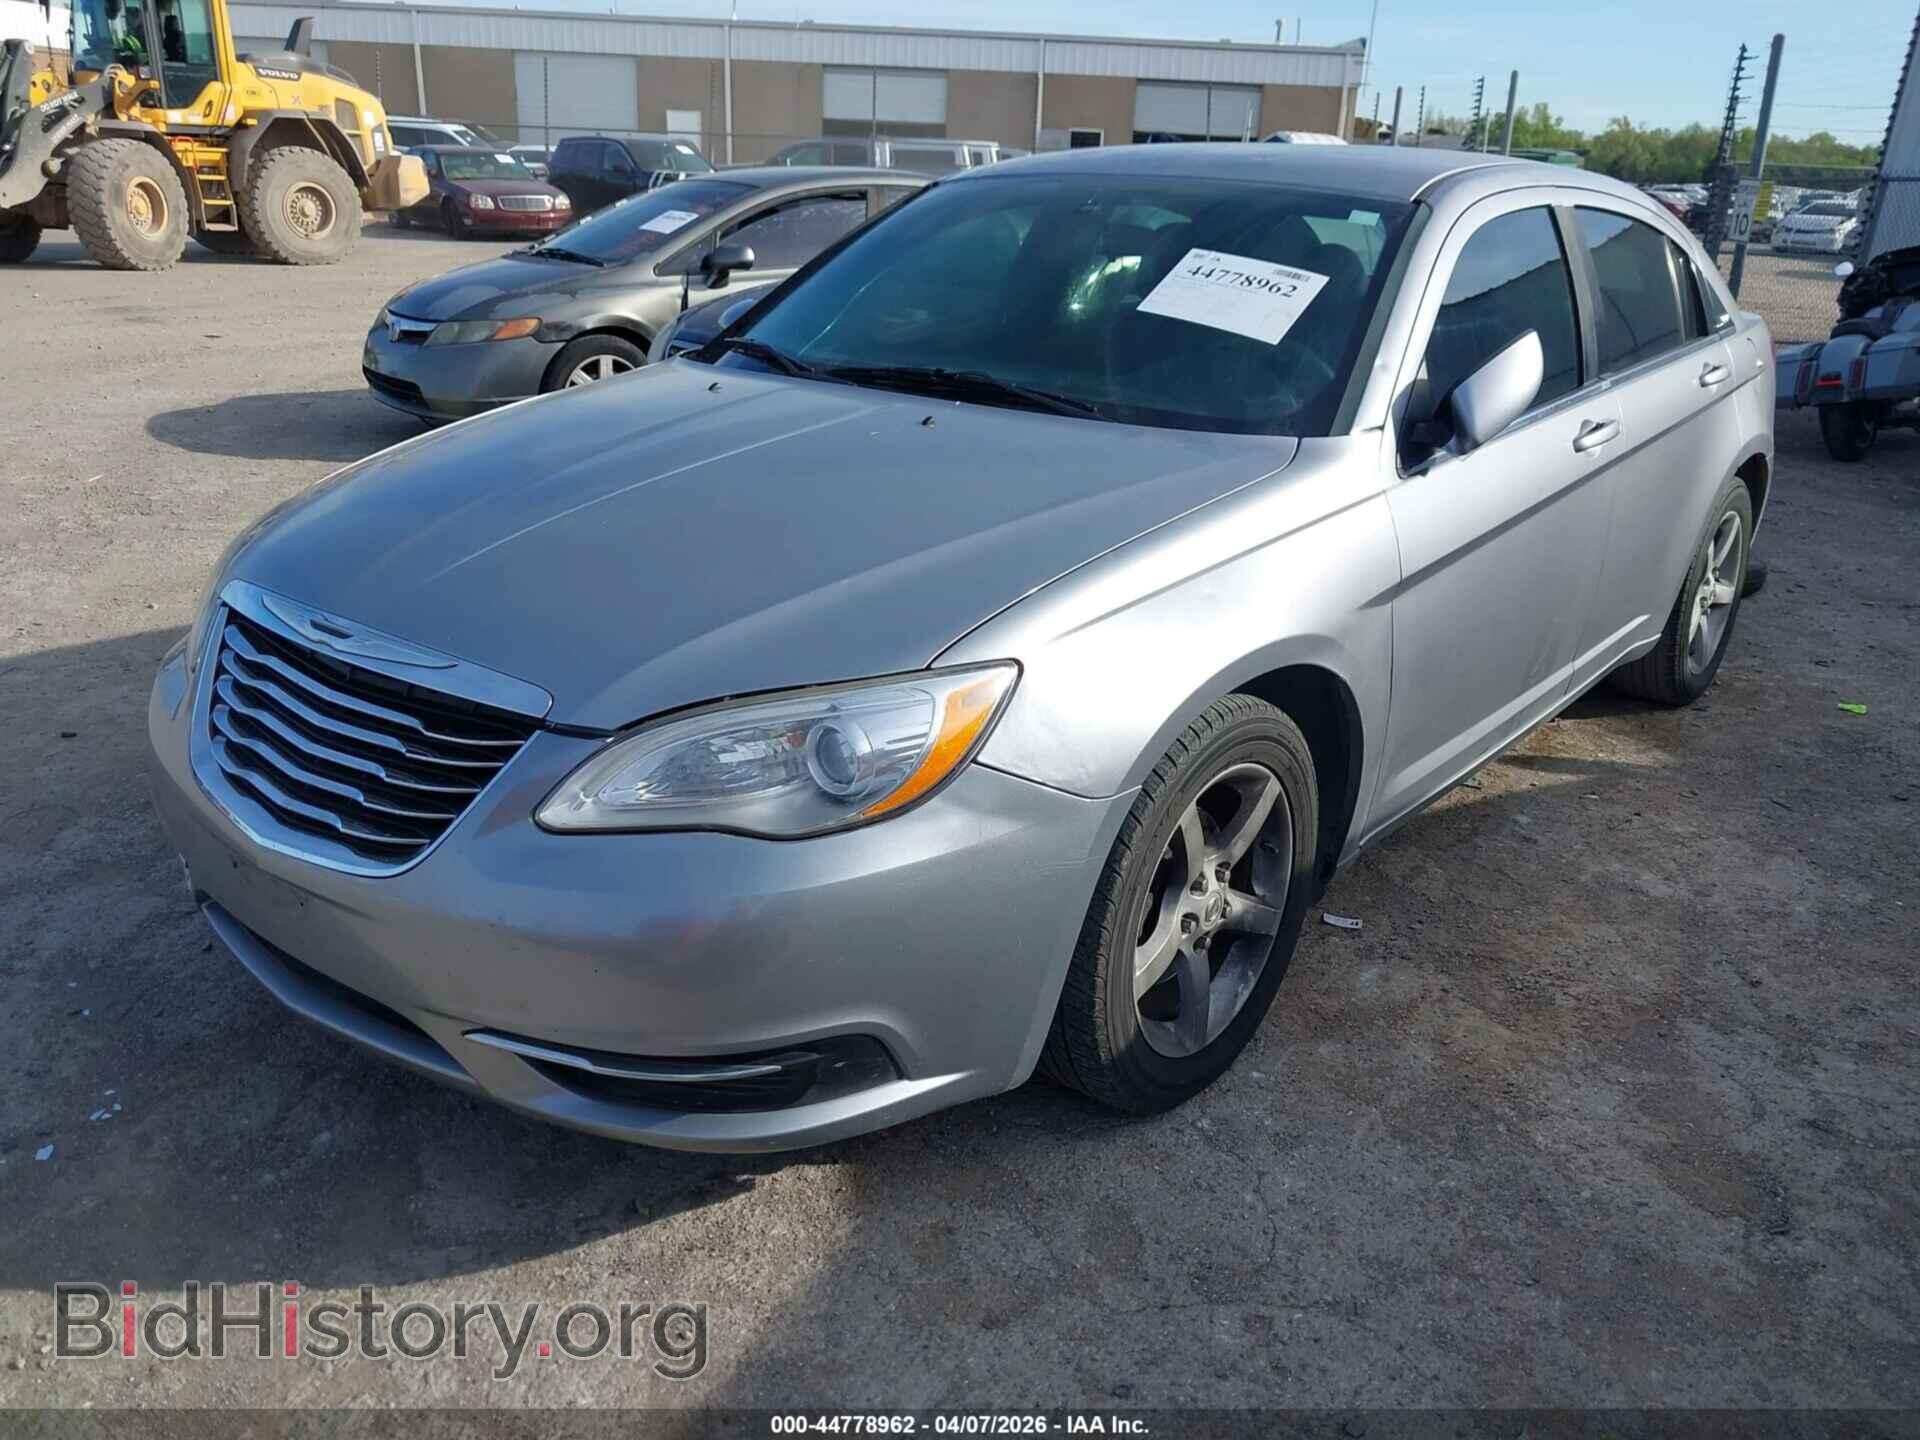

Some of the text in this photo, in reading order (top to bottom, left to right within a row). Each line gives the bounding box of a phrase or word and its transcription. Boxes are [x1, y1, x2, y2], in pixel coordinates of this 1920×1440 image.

[257, 67, 299, 80] VOLVO
[1734, 213, 1749, 235] 10
[1187, 264, 1298, 298] 44778962
